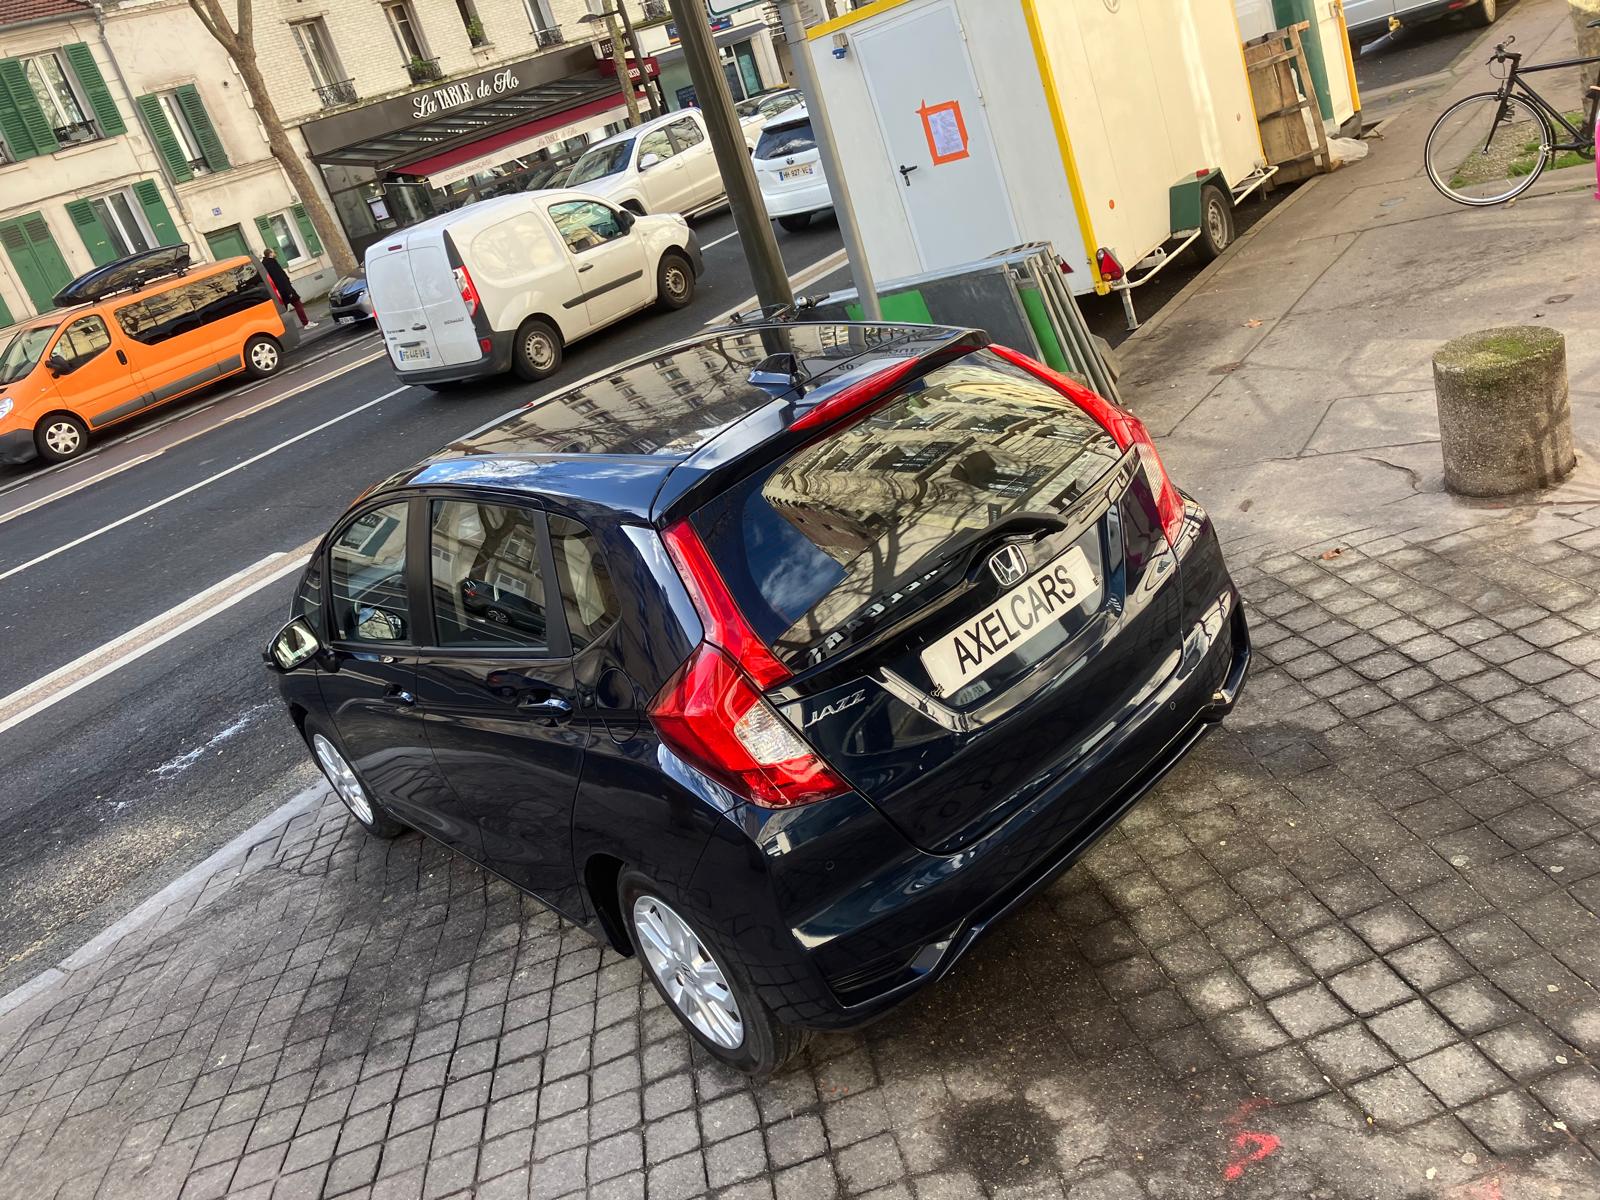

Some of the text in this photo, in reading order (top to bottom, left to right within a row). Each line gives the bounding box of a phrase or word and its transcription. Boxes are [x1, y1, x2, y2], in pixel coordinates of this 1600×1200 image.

[413, 94, 437, 118] La
[434, 82, 474, 110] TABLE
[476, 79, 491, 98] de
[953, 565, 1076, 675] AXELCARS
[804, 689, 866, 728] JAZZ
